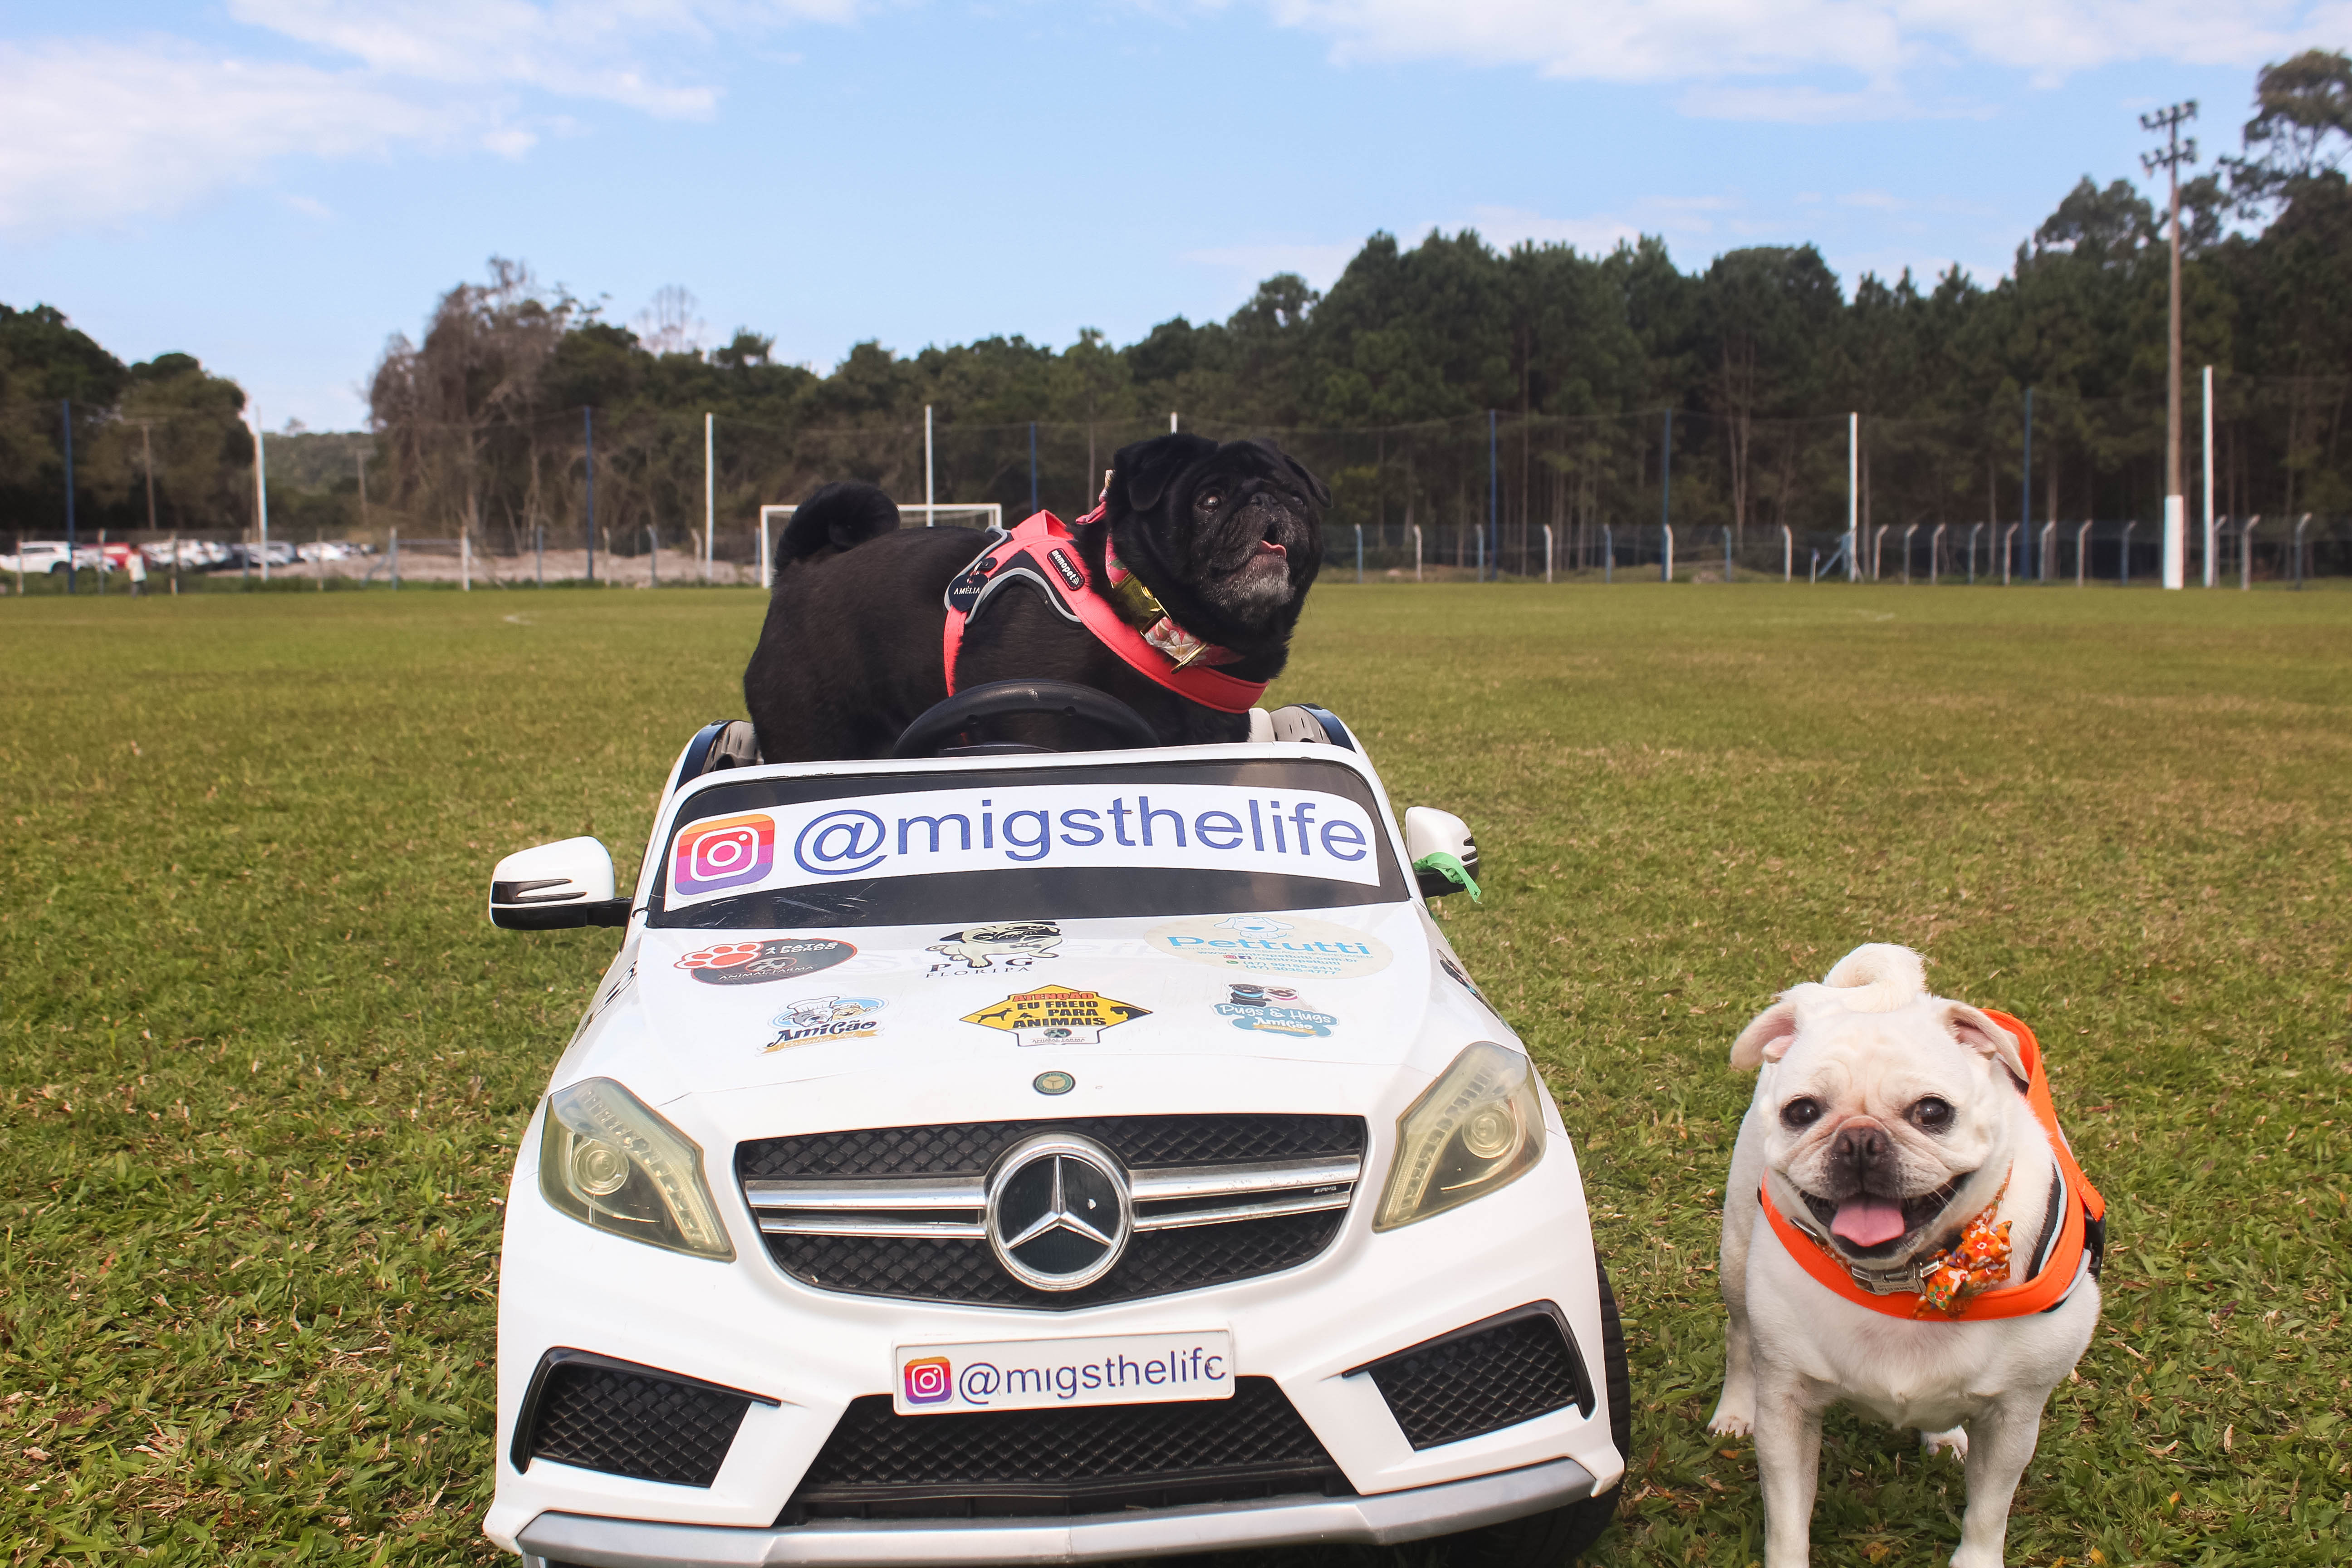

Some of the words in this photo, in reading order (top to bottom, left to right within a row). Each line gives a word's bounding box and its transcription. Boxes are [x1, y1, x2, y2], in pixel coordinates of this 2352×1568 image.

[1051, 550, 1077, 580] memopet
[794, 796, 1368, 874] @migsthelife
[780, 946, 836, 954] BORDO
[781, 942, 839, 950] PATAS
[1166, 936, 1370, 955] Pettutti
[926, 967, 1029, 978] FLORIPA
[1012, 992, 1094, 1002] ATENÇÃO
[1017, 1002, 1040, 1010] EU
[1220, 1004, 1264, 1017] Pugs
[1269, 1008, 1286, 1018] &
[1289, 1010, 1331, 1024] Hugs
[1012, 1018, 1107, 1028] ANIMAIS
